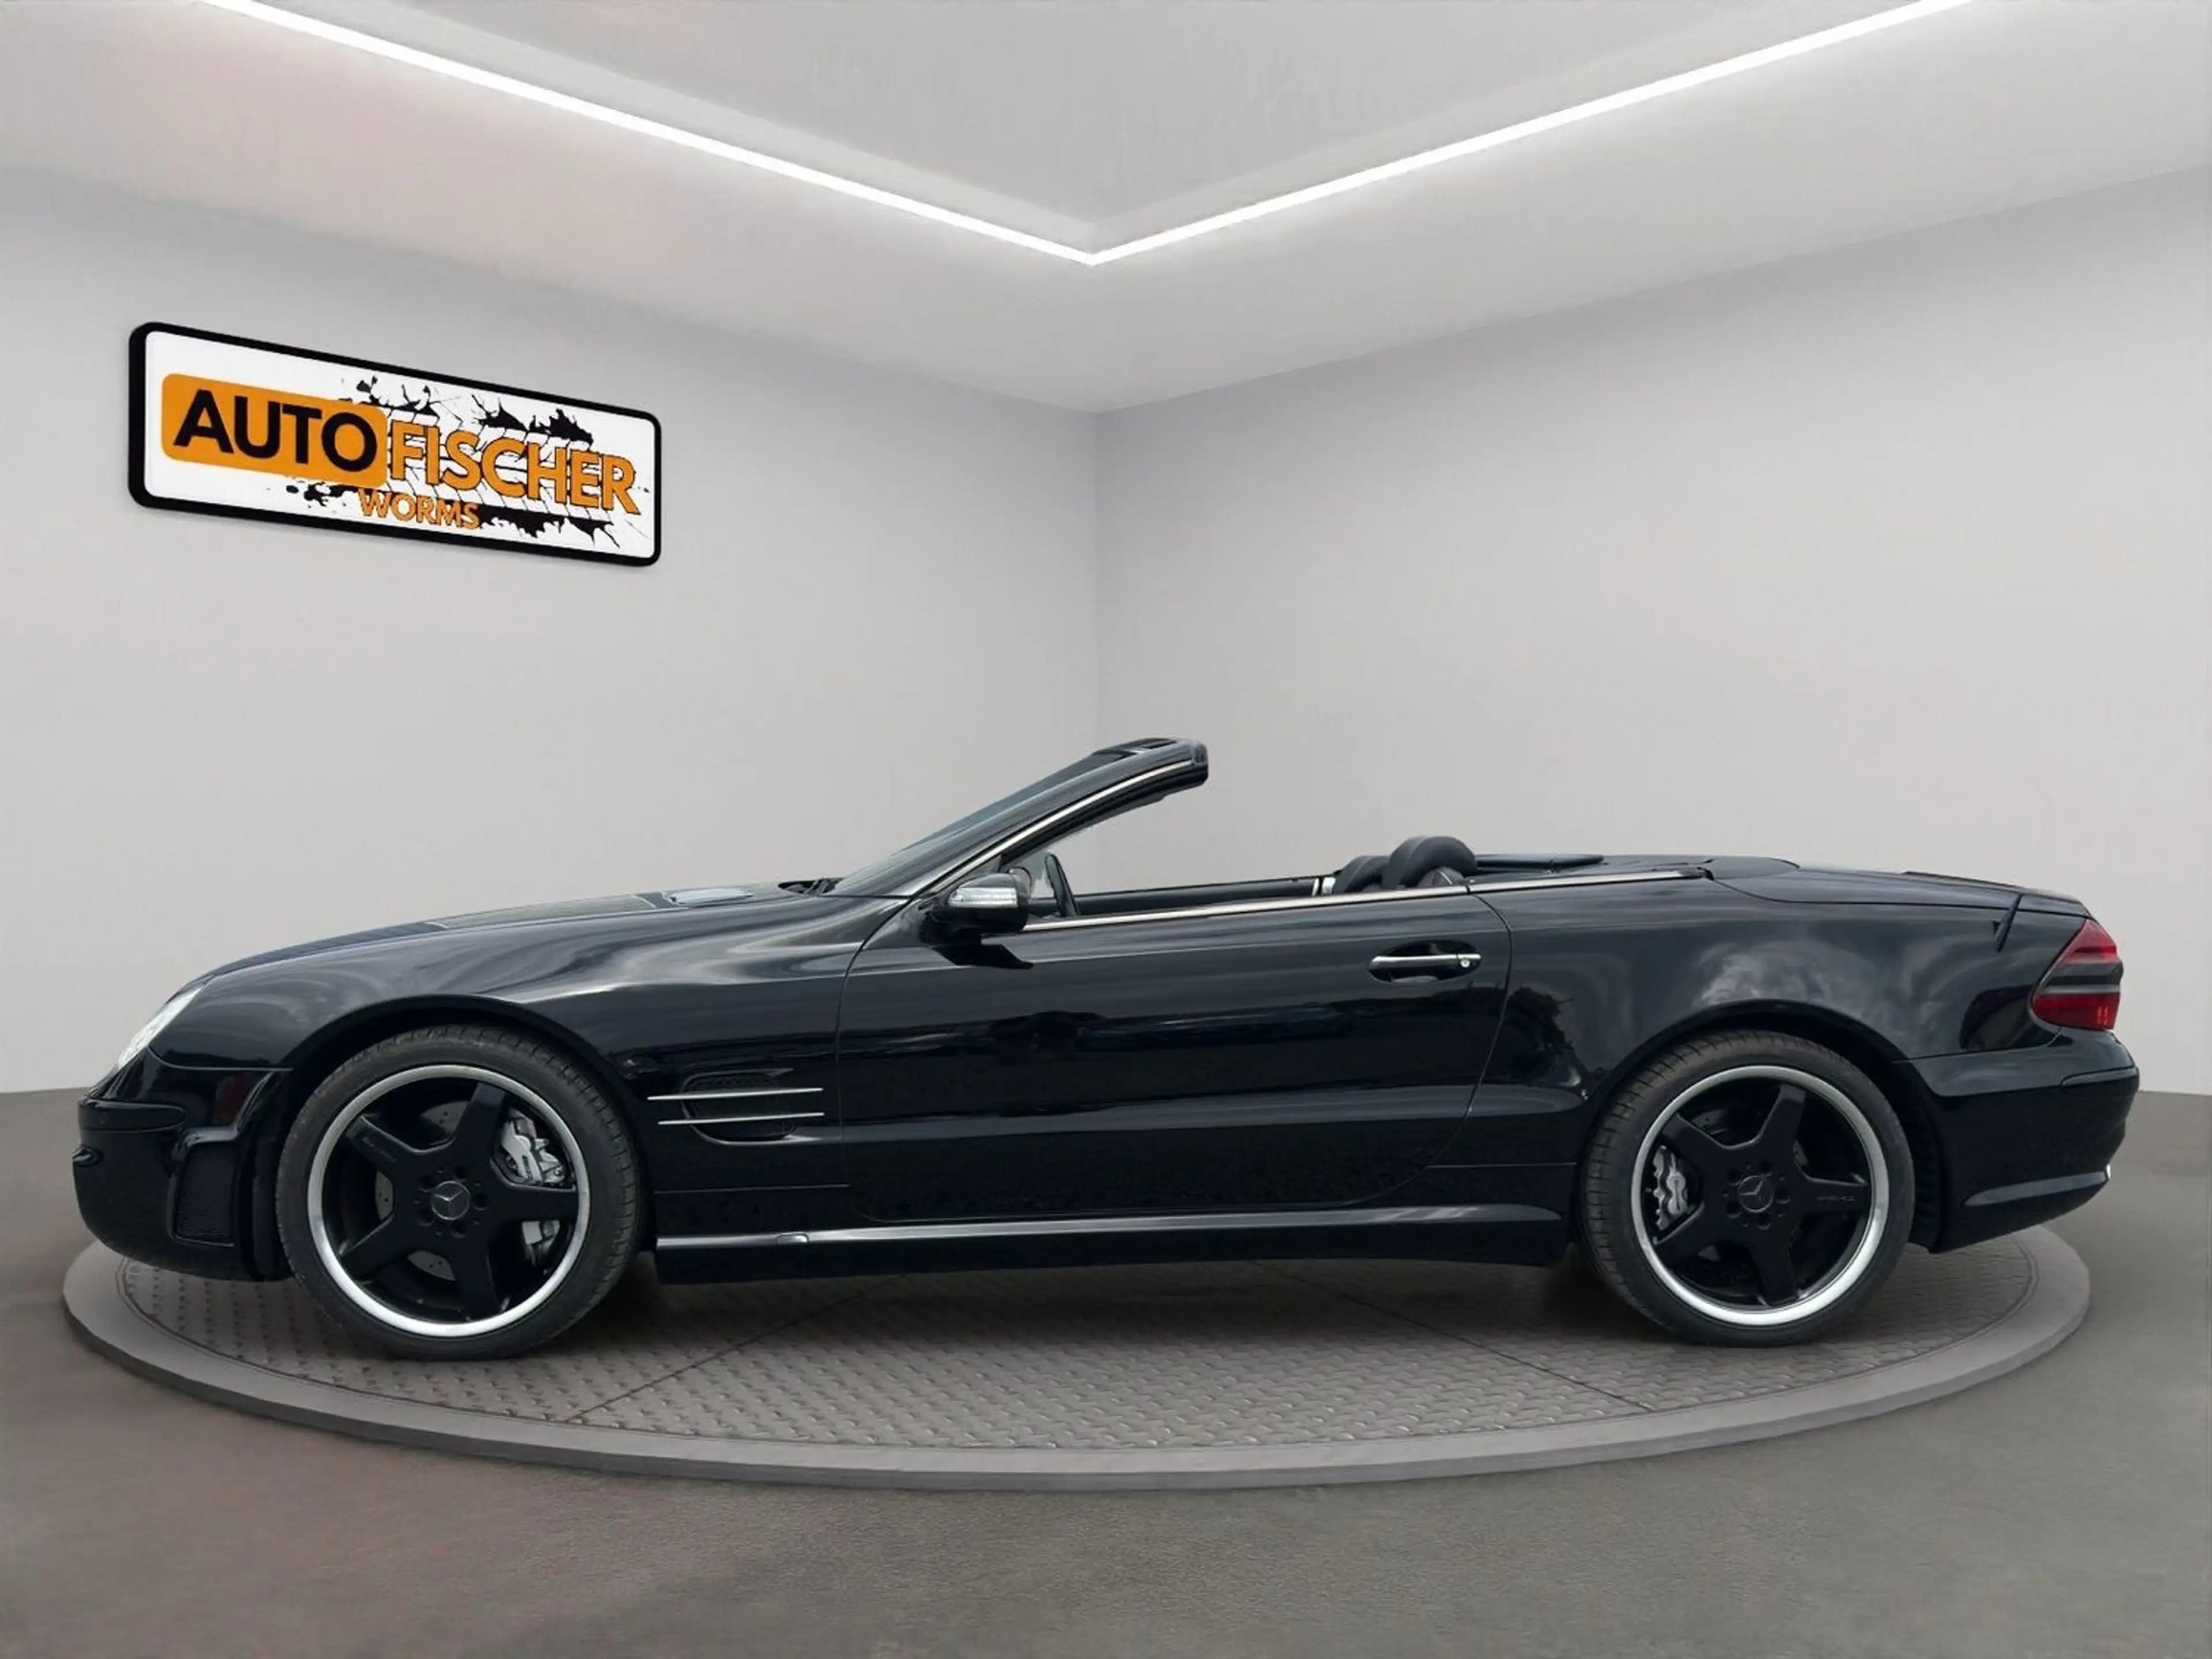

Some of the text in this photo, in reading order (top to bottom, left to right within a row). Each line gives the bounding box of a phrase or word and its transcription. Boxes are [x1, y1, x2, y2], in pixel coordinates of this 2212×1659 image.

[173, 389, 641, 516] AUTO FISCHER
[358, 488, 480, 530] WORMS
